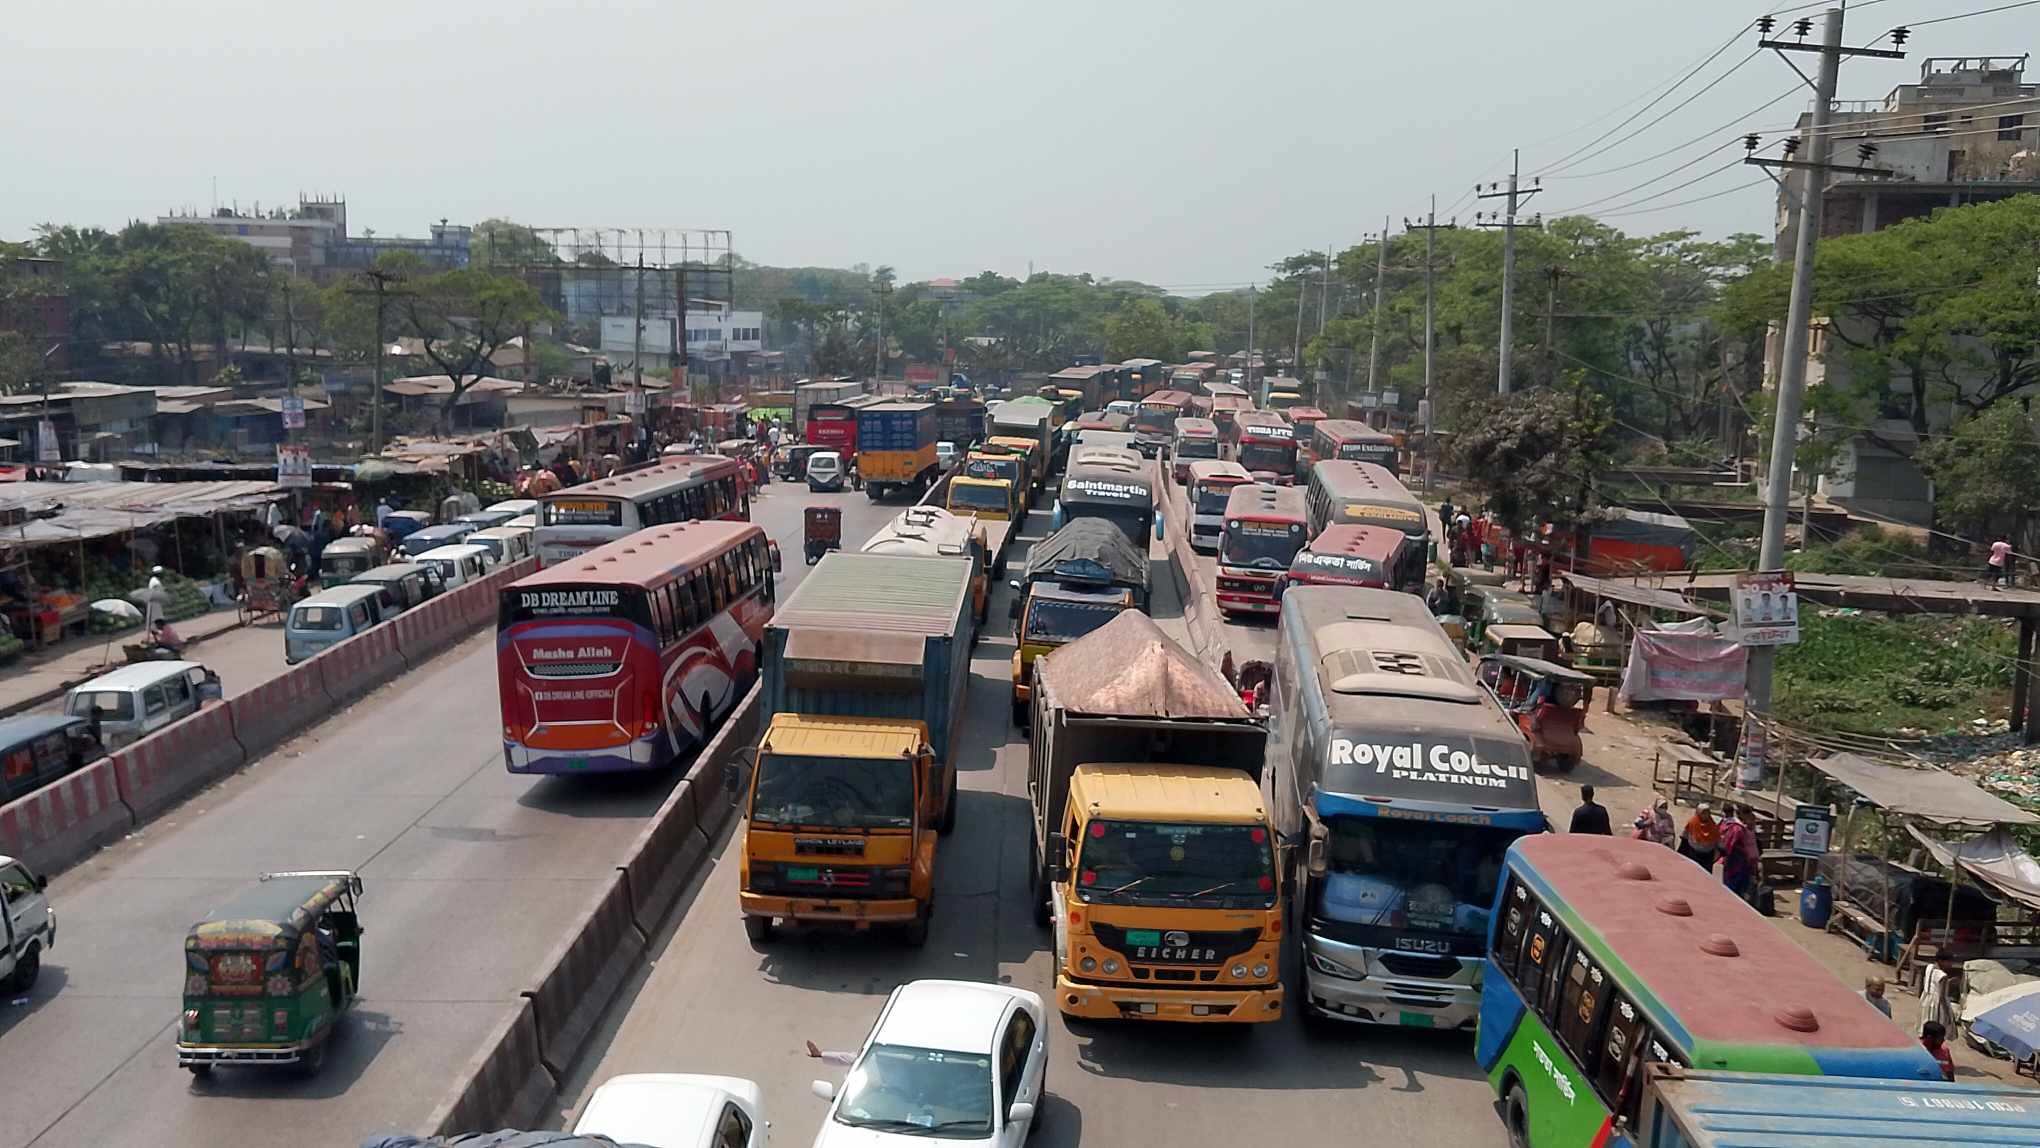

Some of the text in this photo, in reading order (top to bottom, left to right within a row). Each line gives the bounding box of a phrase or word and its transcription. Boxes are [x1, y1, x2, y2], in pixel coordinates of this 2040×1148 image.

[1331, 739, 1422, 773] Royal
[1392, 769, 1507, 788] PLATINUM
[1136, 946, 1216, 960] EICHER
[1395, 937, 1450, 953] ISUZU
